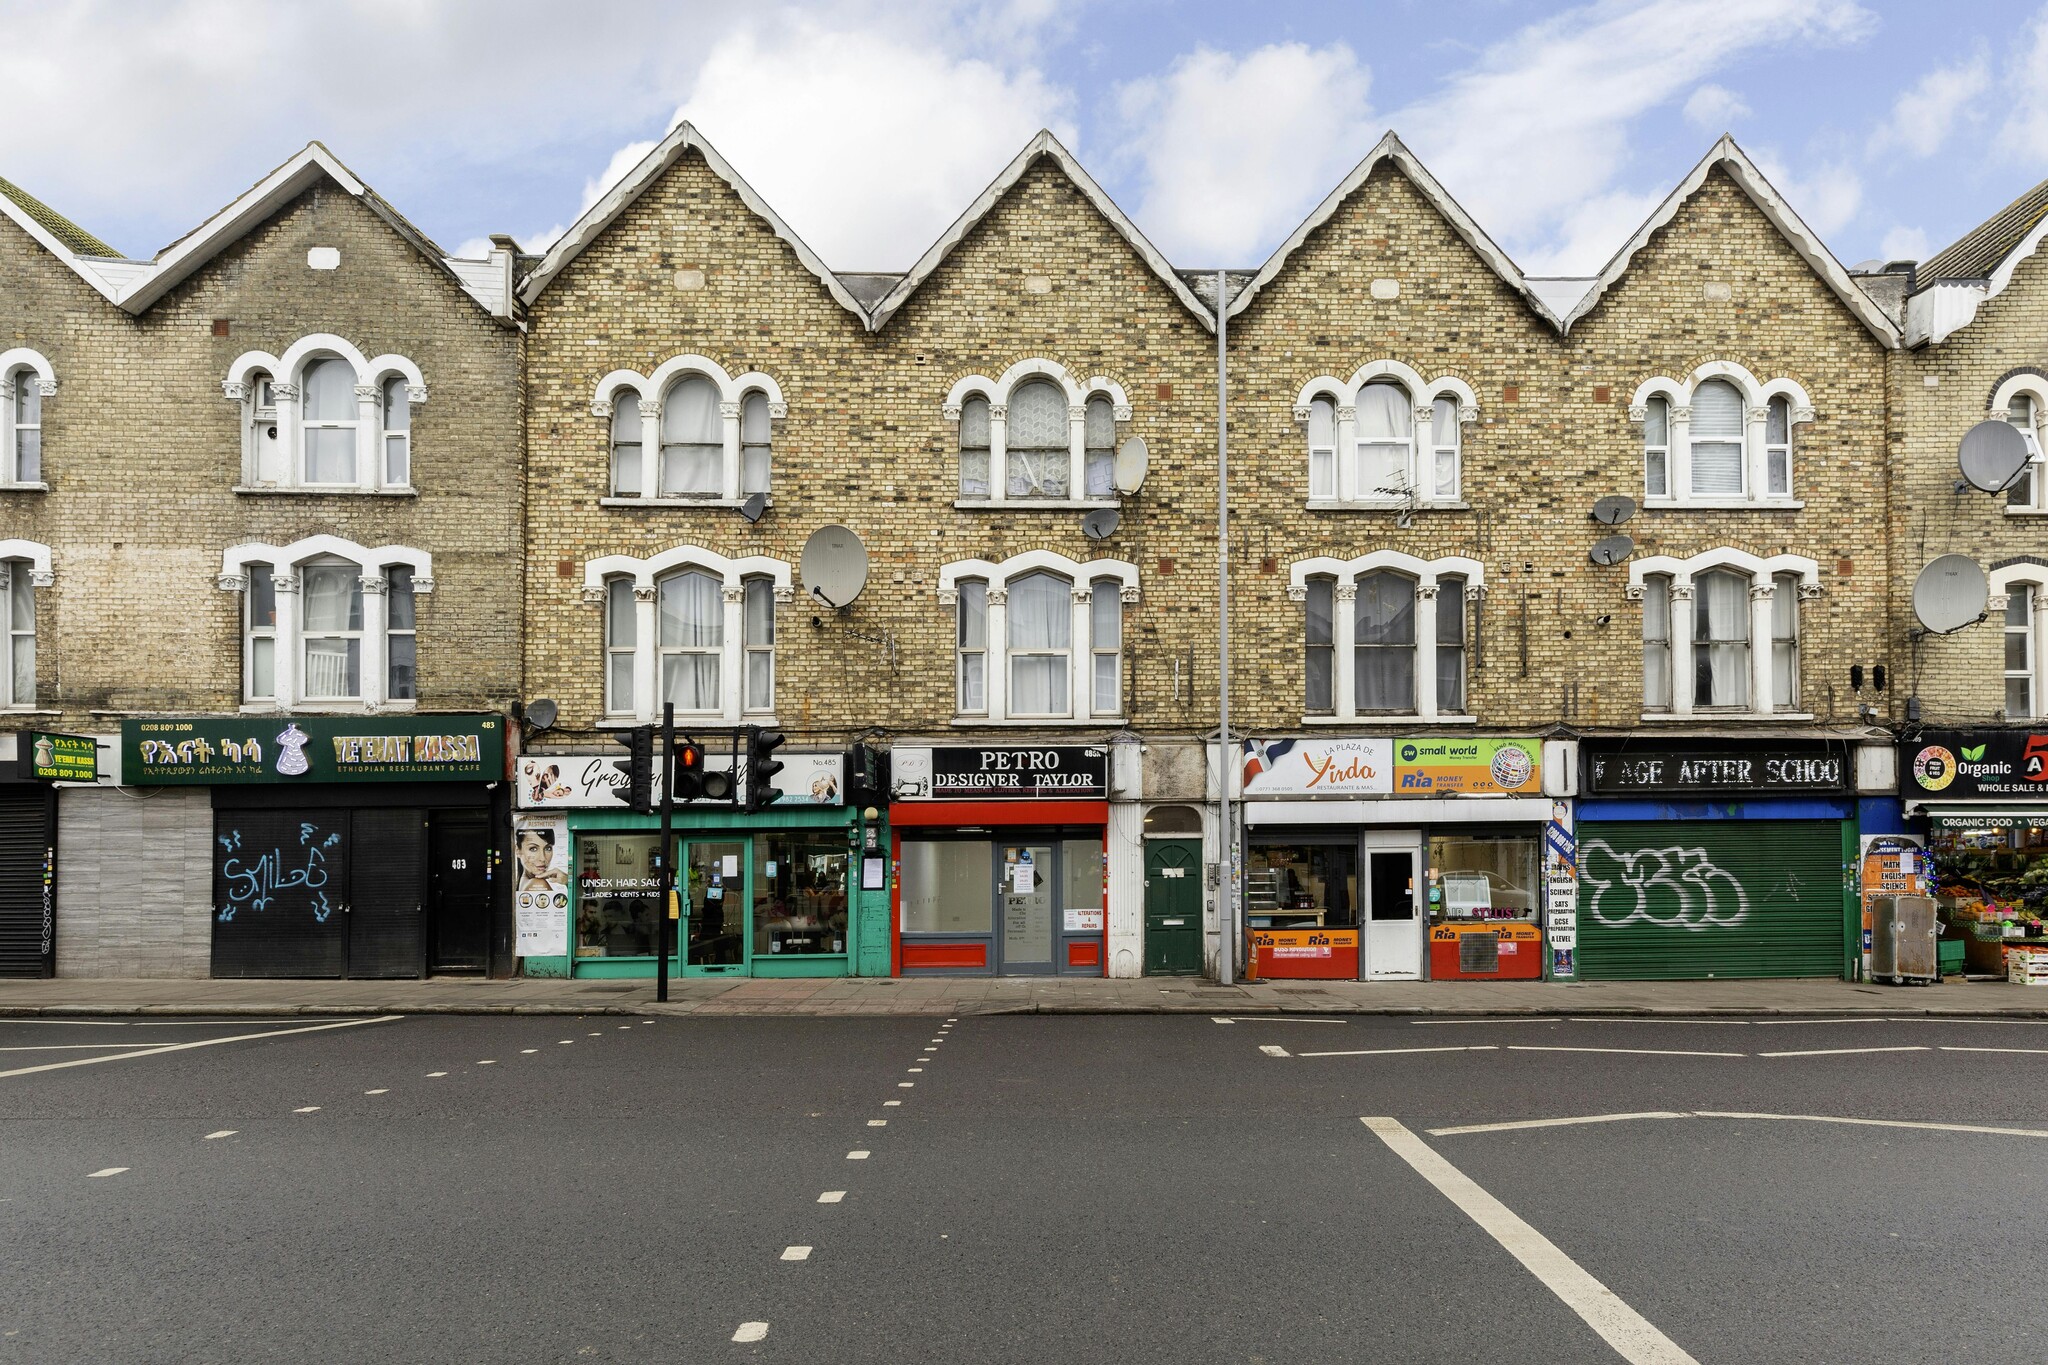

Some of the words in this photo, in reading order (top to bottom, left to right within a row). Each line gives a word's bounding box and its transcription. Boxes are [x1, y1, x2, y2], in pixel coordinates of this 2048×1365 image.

[414, 735, 481, 762] KASSA
[1324, 746, 1334, 756] LA
[1363, 746, 1374, 756] DE
[1420, 746, 1446, 755] small
[1450, 746, 1477, 755] world
[1508, 742, 1526, 750] MONEY
[980, 751, 1059, 770] PETRO
[2027, 757, 2042, 772] A
[38, 767, 58, 776] 0208
[59, 769, 73, 777] 809
[75, 770, 93, 778] 1000
[1303, 752, 1376, 788] Yirda
[1678, 760, 1753, 783] AFTER
[1766, 759, 1839, 782] SCHOO
[1958, 761, 2011, 778] Organic
[935, 774, 1020, 786] DESIGNER
[1033, 773, 1093, 786] TAYLOR
[1401, 770, 1432, 787] Ria
[1942, 818, 1984, 826] ORGANIC
[1986, 818, 2013, 826] FOOD
[452, 858, 466, 870] 483
[582, 879, 612, 887] UNISEX
[1472, 908, 1519, 918] STYLIST
[1256, 933, 1274, 946] Ria
[1308, 932, 1329, 945] Ria
[1434, 927, 1455, 939] Ria
